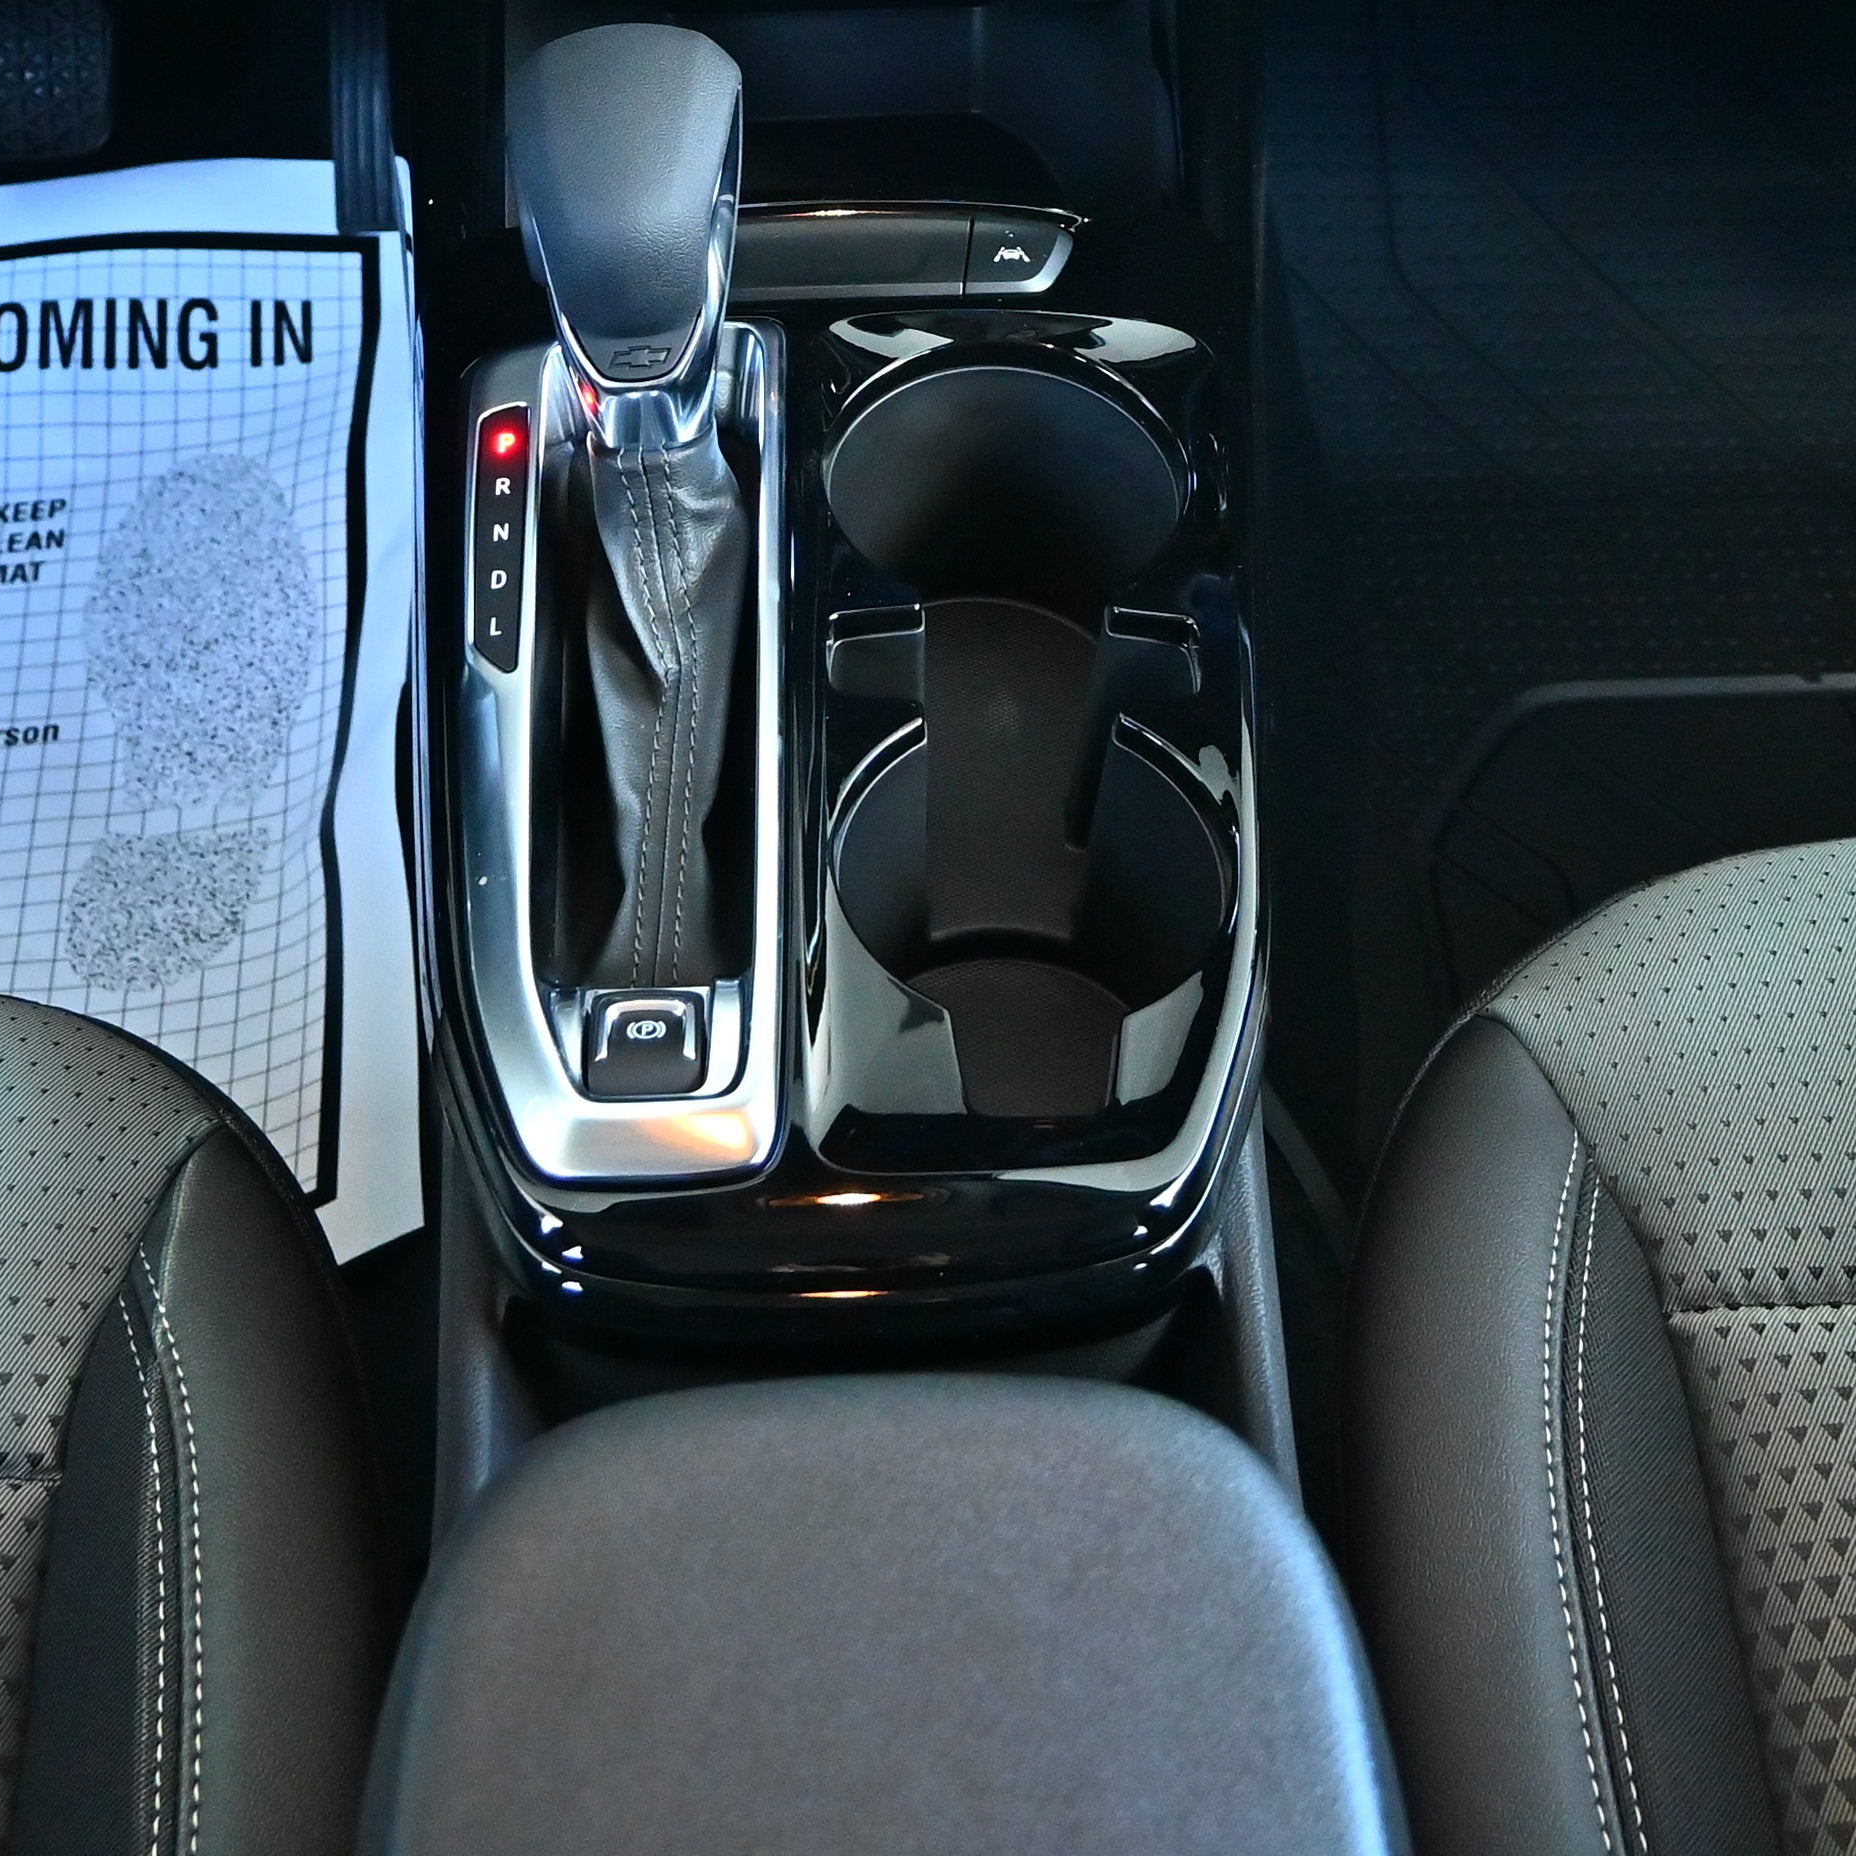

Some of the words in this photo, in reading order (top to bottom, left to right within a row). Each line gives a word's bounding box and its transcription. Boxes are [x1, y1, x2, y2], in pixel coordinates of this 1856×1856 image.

[249, 300, 314, 367] IN
[497, 433, 515, 453] P
[495, 477, 511, 496] R
[493, 522, 509, 542] N
[490, 570, 508, 590] D
[490, 617, 503, 636] L
[641, 1024, 653, 1036] P
